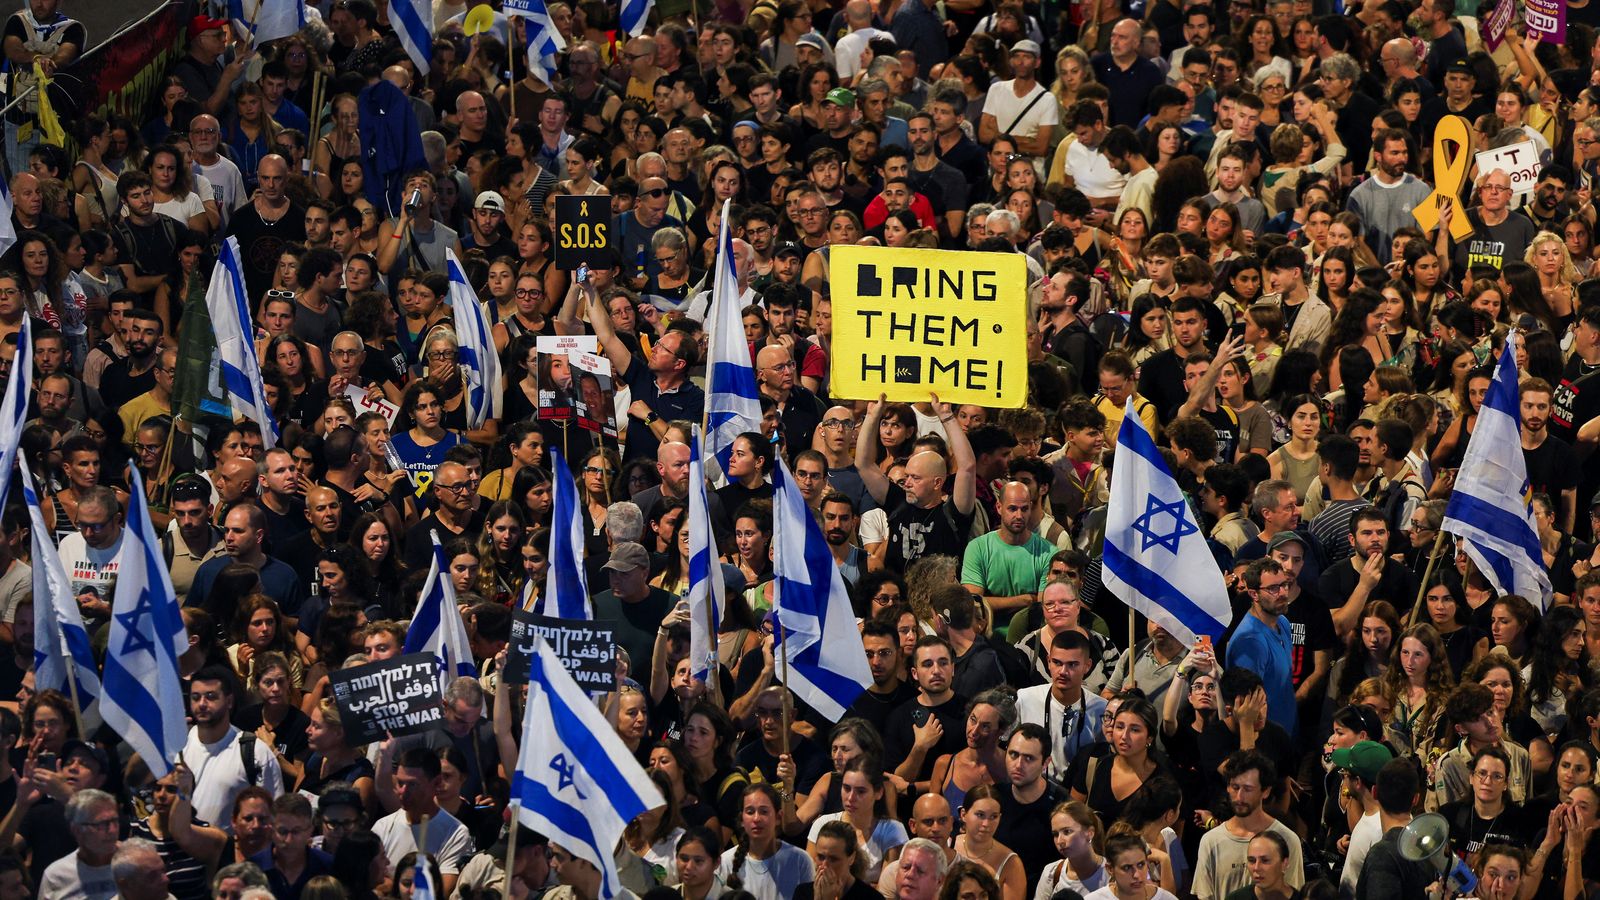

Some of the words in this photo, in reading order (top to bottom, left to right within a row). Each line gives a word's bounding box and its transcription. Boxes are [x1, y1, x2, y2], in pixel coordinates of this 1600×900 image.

[1495, 149, 1520, 165] די
[1510, 163, 1541, 182] להפ
[560, 223, 607, 249] S.O.S
[857, 264, 997, 301] BRING
[861, 353, 1003, 398] HOME!
[73, 569, 97, 579] HOME
[597, 630, 612, 642] די
[571, 643, 615, 663] أوقف
[415, 662, 432, 675] די
[560, 657, 582, 670] OP
[350, 663, 413, 692] למלחמה
[575, 670, 612, 684] WAR
[349, 676, 394, 714] الحرب
[395, 675, 438, 699] أوقف
[372, 701, 409, 719] STOP
[376, 716, 405, 731] THE
[404, 707, 441, 726] WAR
